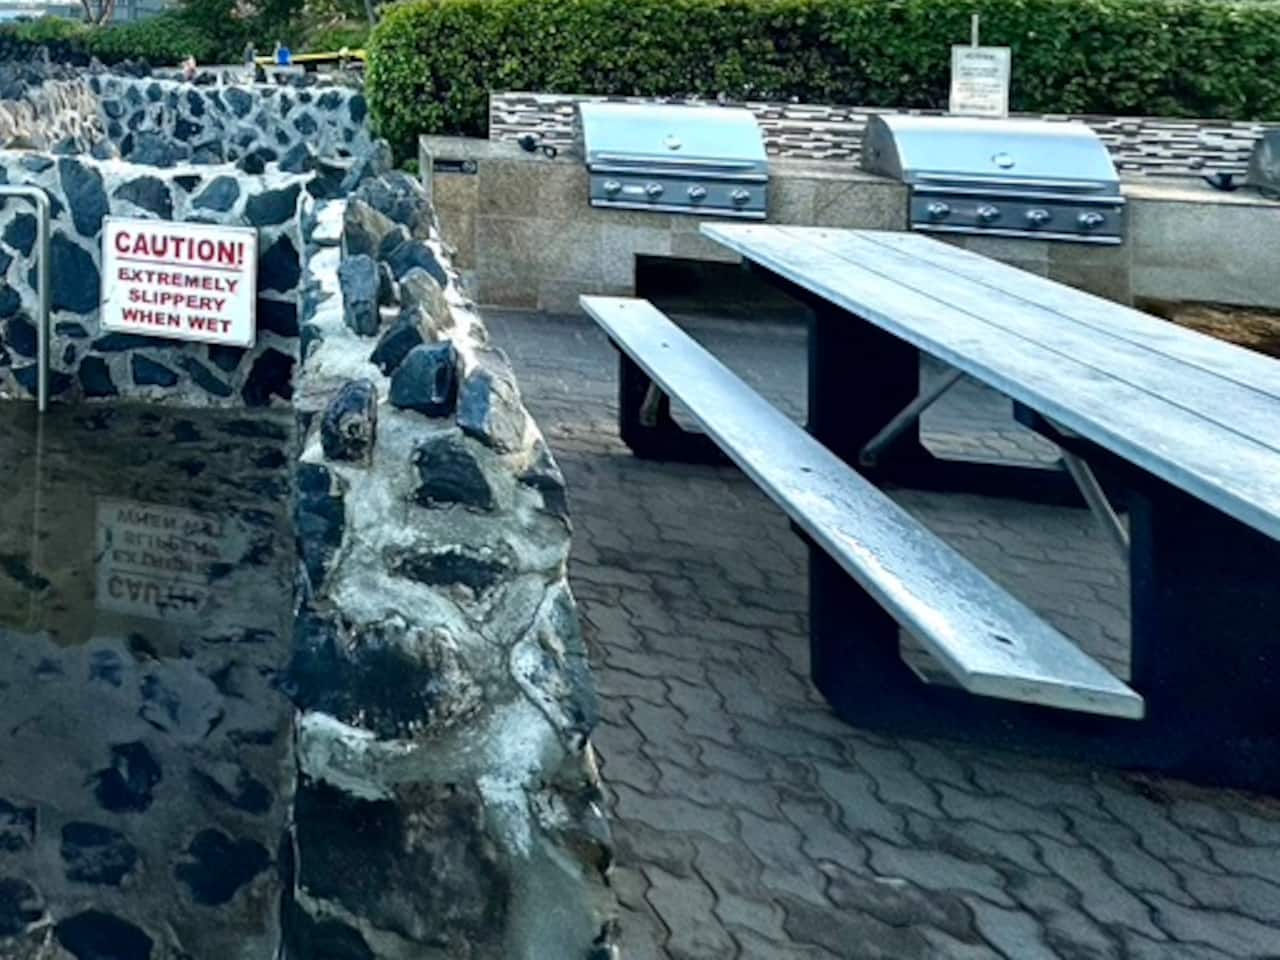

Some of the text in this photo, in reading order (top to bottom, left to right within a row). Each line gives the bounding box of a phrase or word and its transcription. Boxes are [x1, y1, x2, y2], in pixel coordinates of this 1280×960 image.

[115, 231, 244, 265] CAUTION!
[117, 267, 238, 293] EXTREMELY
[128, 288, 226, 312] SLIPPERY
[121, 307, 232, 333] WHEN WET
